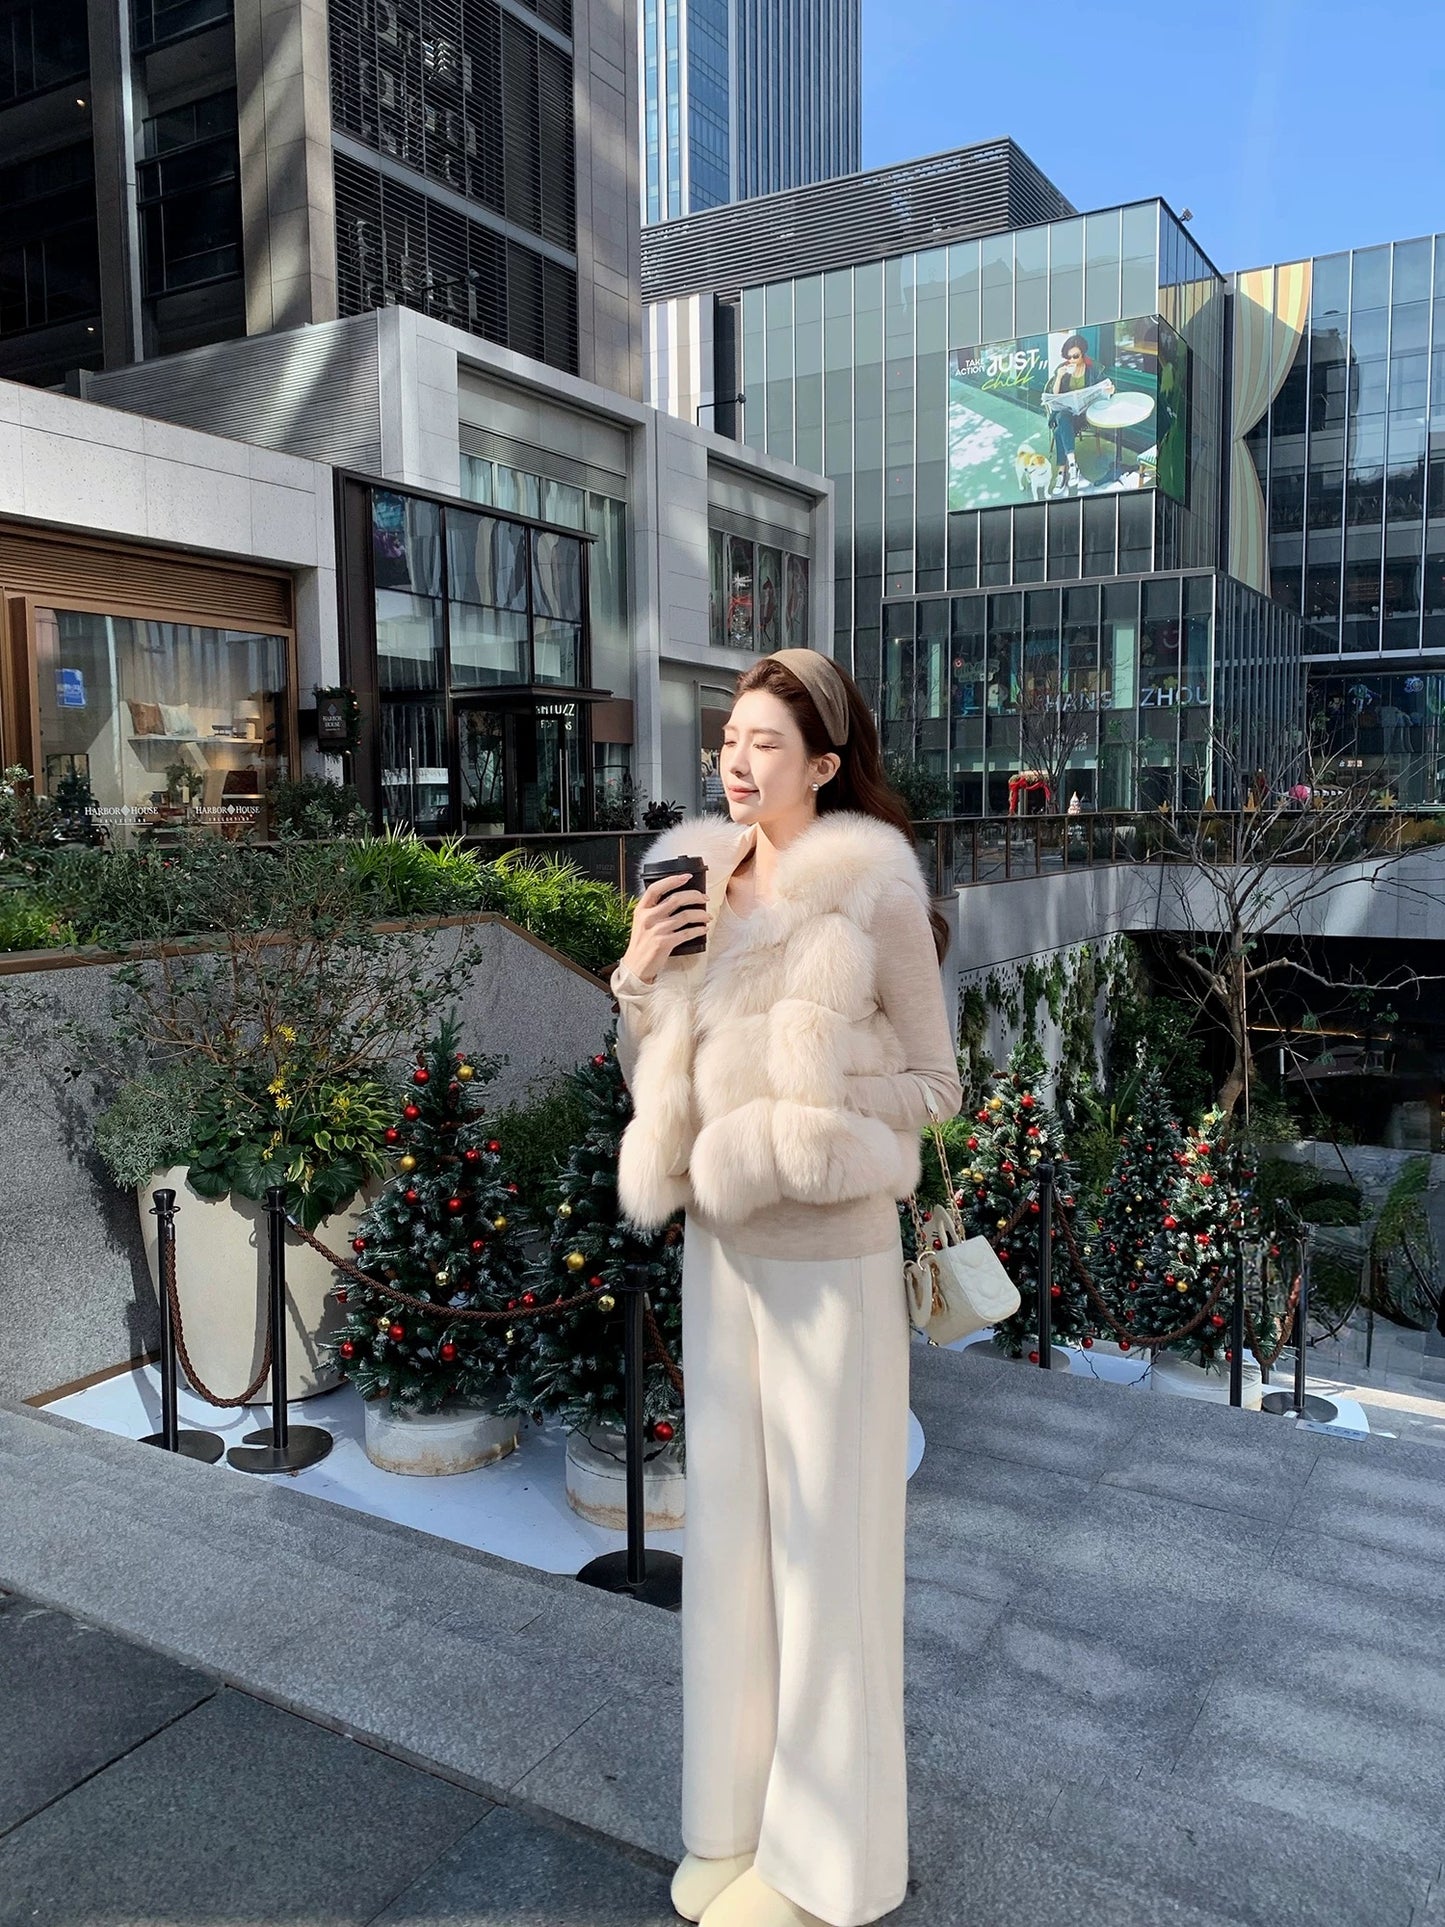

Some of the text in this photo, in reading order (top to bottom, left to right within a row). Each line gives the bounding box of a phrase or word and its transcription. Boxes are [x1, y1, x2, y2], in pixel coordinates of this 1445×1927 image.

[965, 359, 985, 367] TAKE
[955, 366, 985, 376] ACTION
[1141, 686, 1208, 708] ZHOU
[84, 806, 159, 816] HARBOR HOUSE
[195, 804, 261, 815] HARBOR HOUSE
